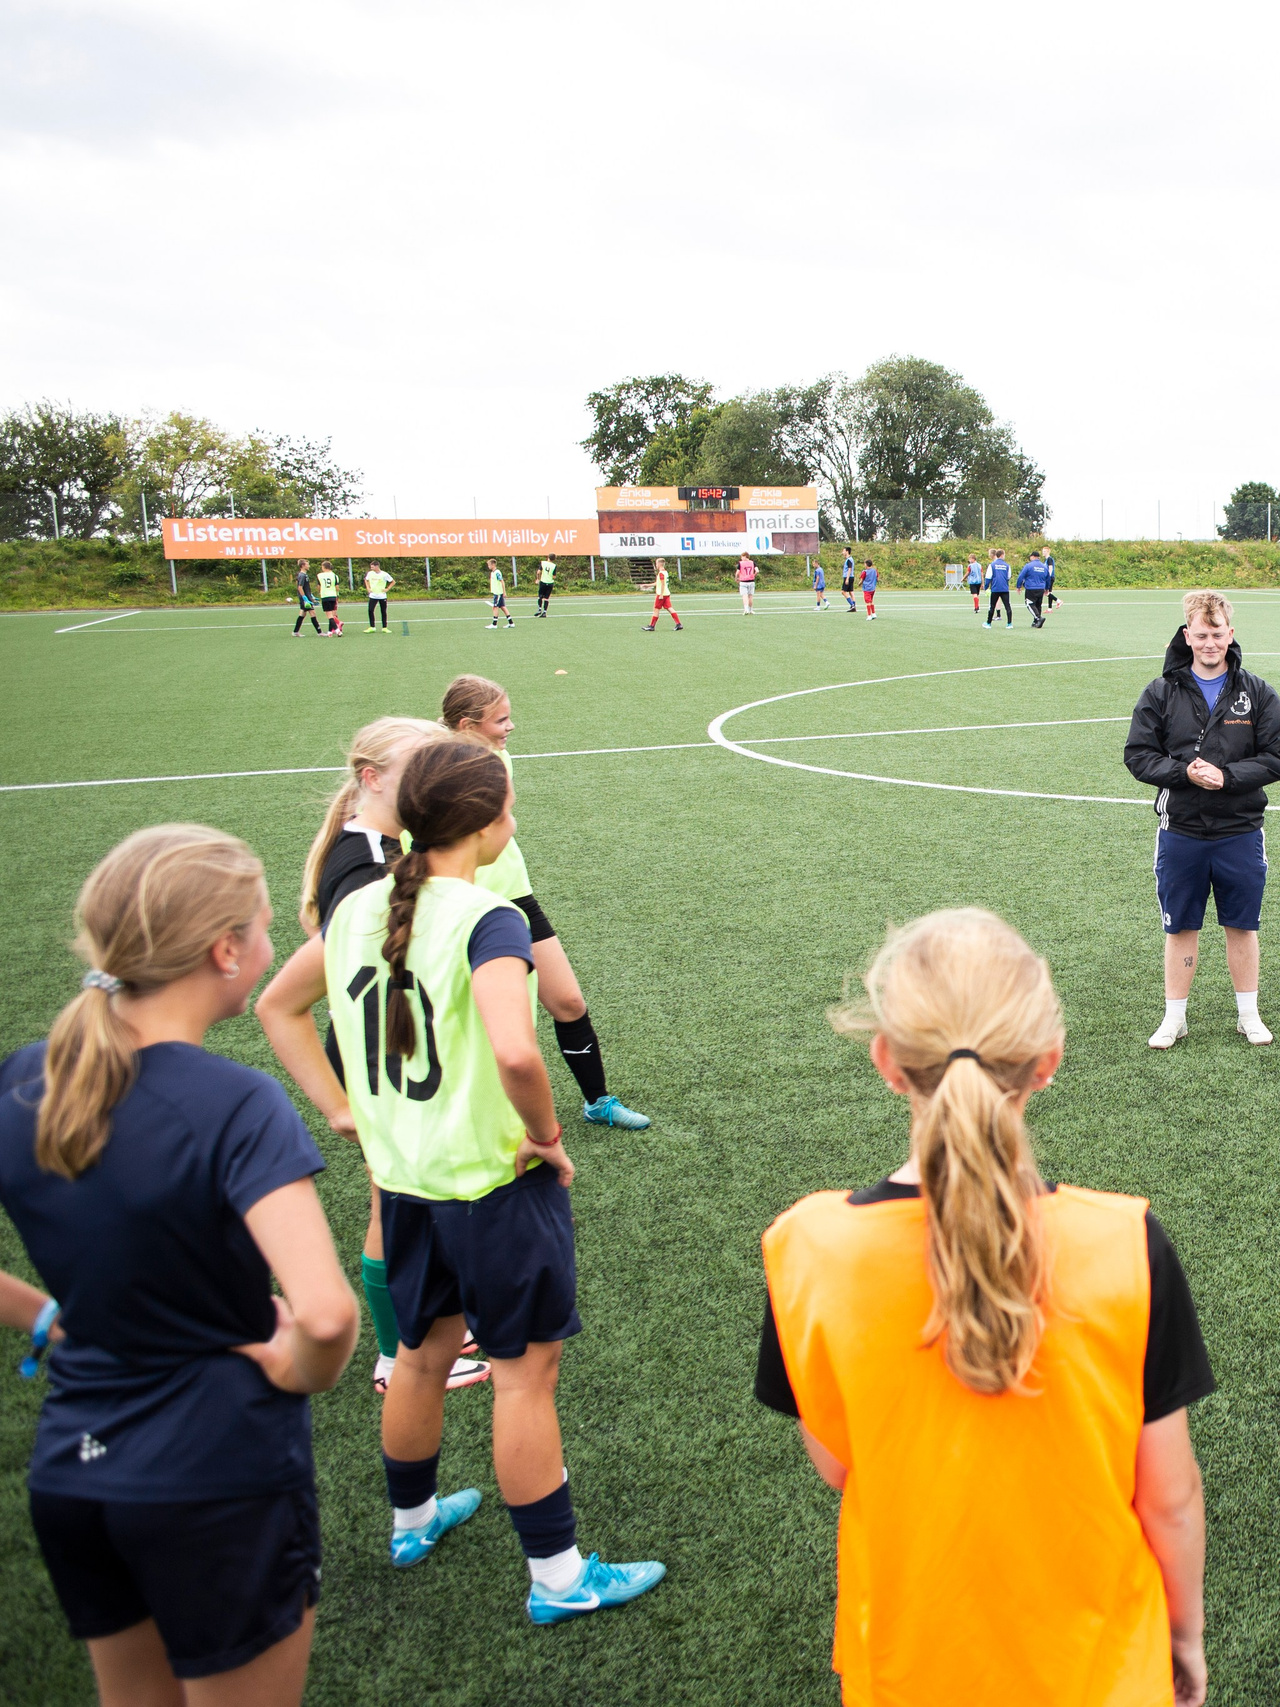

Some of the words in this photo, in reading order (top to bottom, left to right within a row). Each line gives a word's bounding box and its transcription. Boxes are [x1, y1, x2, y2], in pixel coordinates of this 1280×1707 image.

[620, 488, 651, 497] Enkla
[698, 488, 722, 499] 15:42
[752, 488, 782, 497] Enkla
[616, 497, 670, 508] Elbolaget
[749, 497, 800, 508] Elbolaget
[749, 514, 816, 529] maif.se
[173, 522, 339, 542] Listermacken
[355, 529, 395, 545] Stolt
[399, 532, 464, 548] sponsor
[468, 529, 488, 544] till
[492, 529, 550, 547] Mjällby
[554, 529, 578, 543] AIF
[619, 533, 655, 547] NÄBO
[711, 540, 742, 549] Blekinge
[545, 566, 550, 574] 4
[744, 566, 753, 576] 17
[346, 966, 443, 1102] 10
